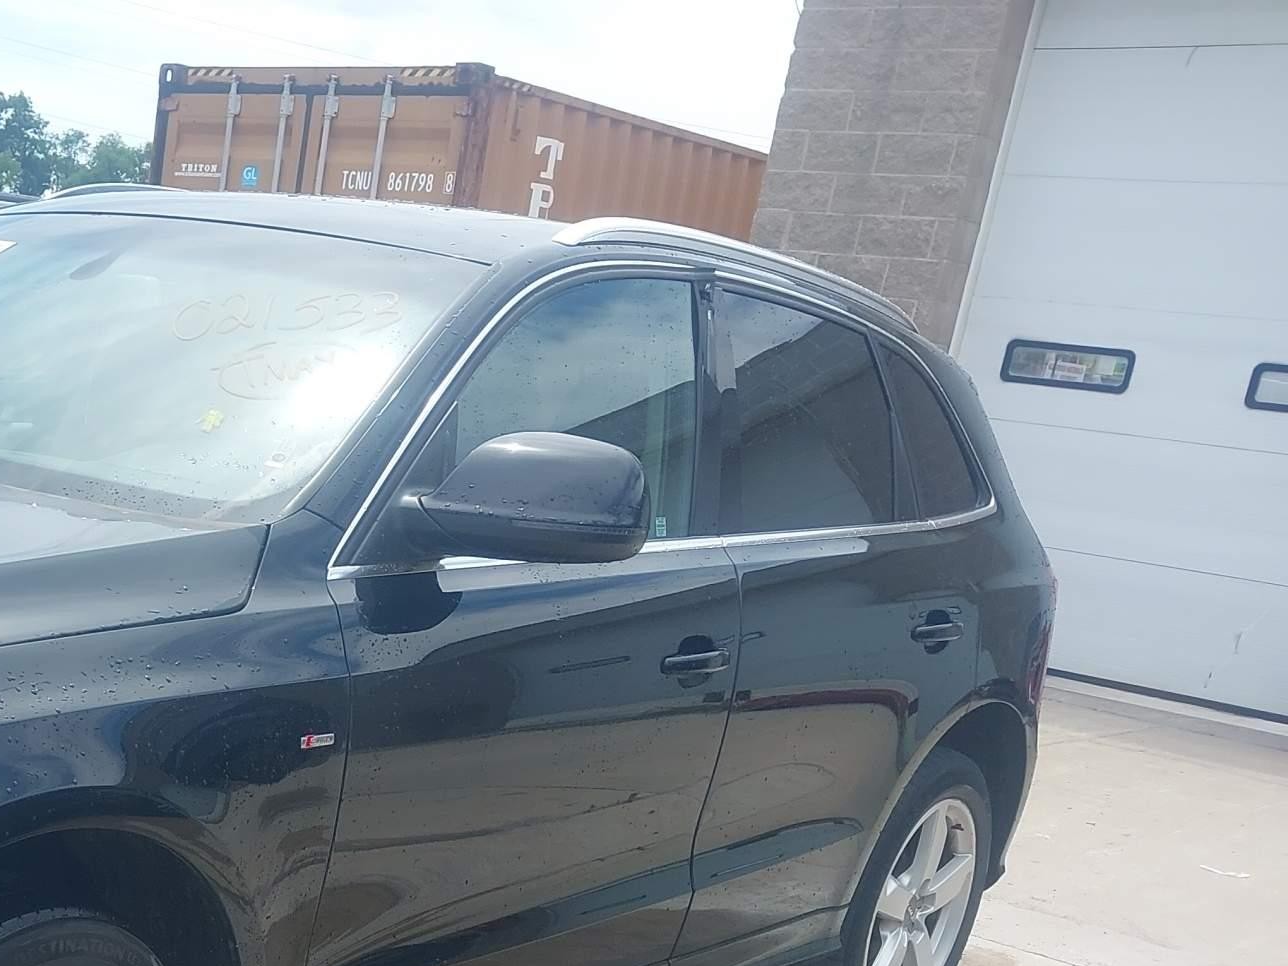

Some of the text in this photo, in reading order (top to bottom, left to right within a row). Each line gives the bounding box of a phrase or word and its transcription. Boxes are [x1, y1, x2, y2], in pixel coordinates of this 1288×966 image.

[181, 163, 218, 173] TRITON
[243, 167, 257, 180] GL
[342, 170, 454, 193] TCNU 861798 8
